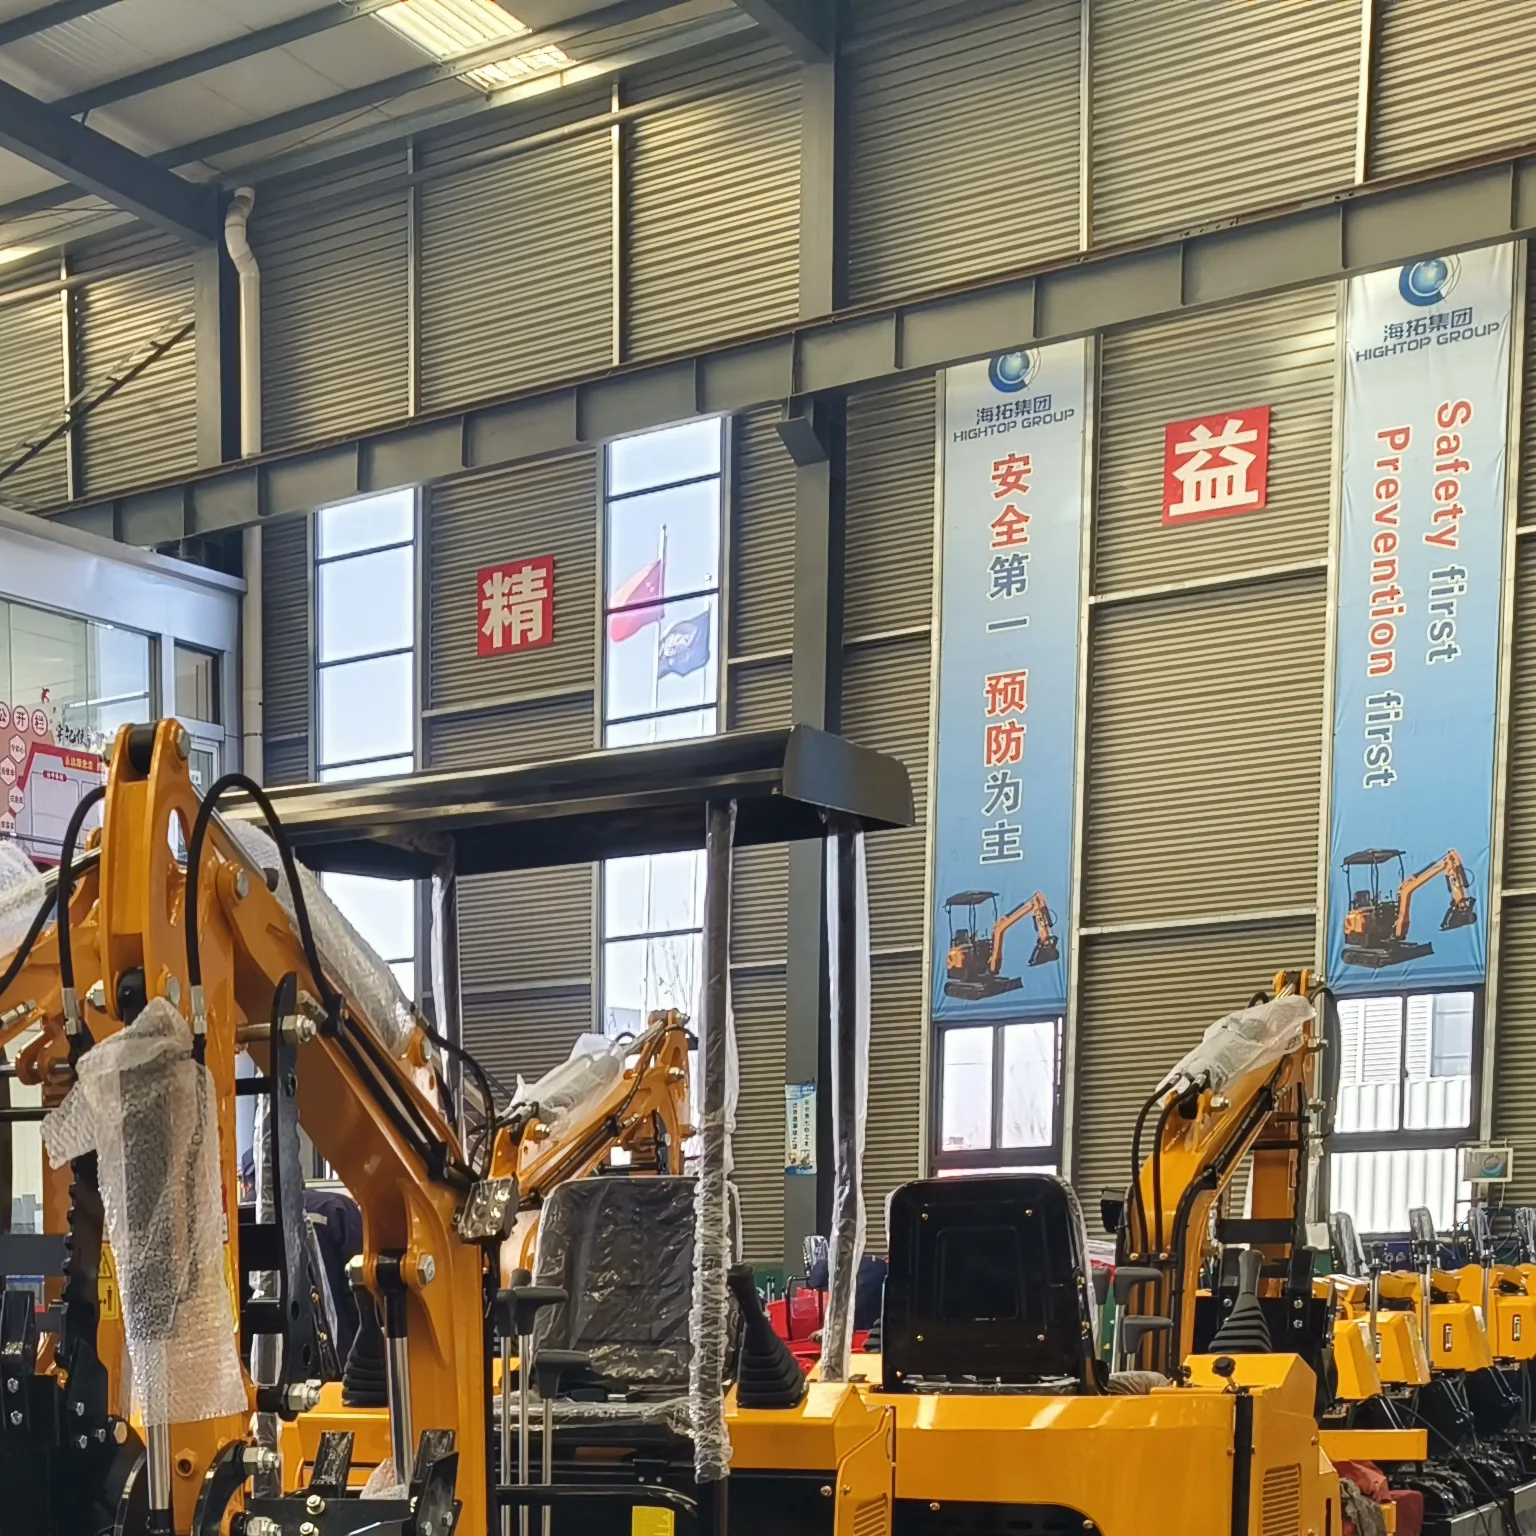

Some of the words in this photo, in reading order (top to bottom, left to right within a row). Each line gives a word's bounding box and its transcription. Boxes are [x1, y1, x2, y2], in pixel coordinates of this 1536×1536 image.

[1355, 337, 1432, 362] HIGHTOP
[1436, 321, 1500, 346] GROUP
[1383, 307, 1473, 342] 海拓集团
[953, 420, 1017, 443] HIGHTOP
[1021, 408, 1075, 430] GROUP
[976, 394, 1052, 425] 海拓集团
[1168, 418, 1259, 518] 益
[1424, 399, 1473, 550] Safety
[986, 451, 1033, 634] 安全第一
[1367, 423, 1413, 678] Prevention
[481, 564, 549, 649] 精
[1425, 563, 1468, 666] first
[980, 668, 1029, 865] 预防为主
[1363, 689, 1404, 789] first
